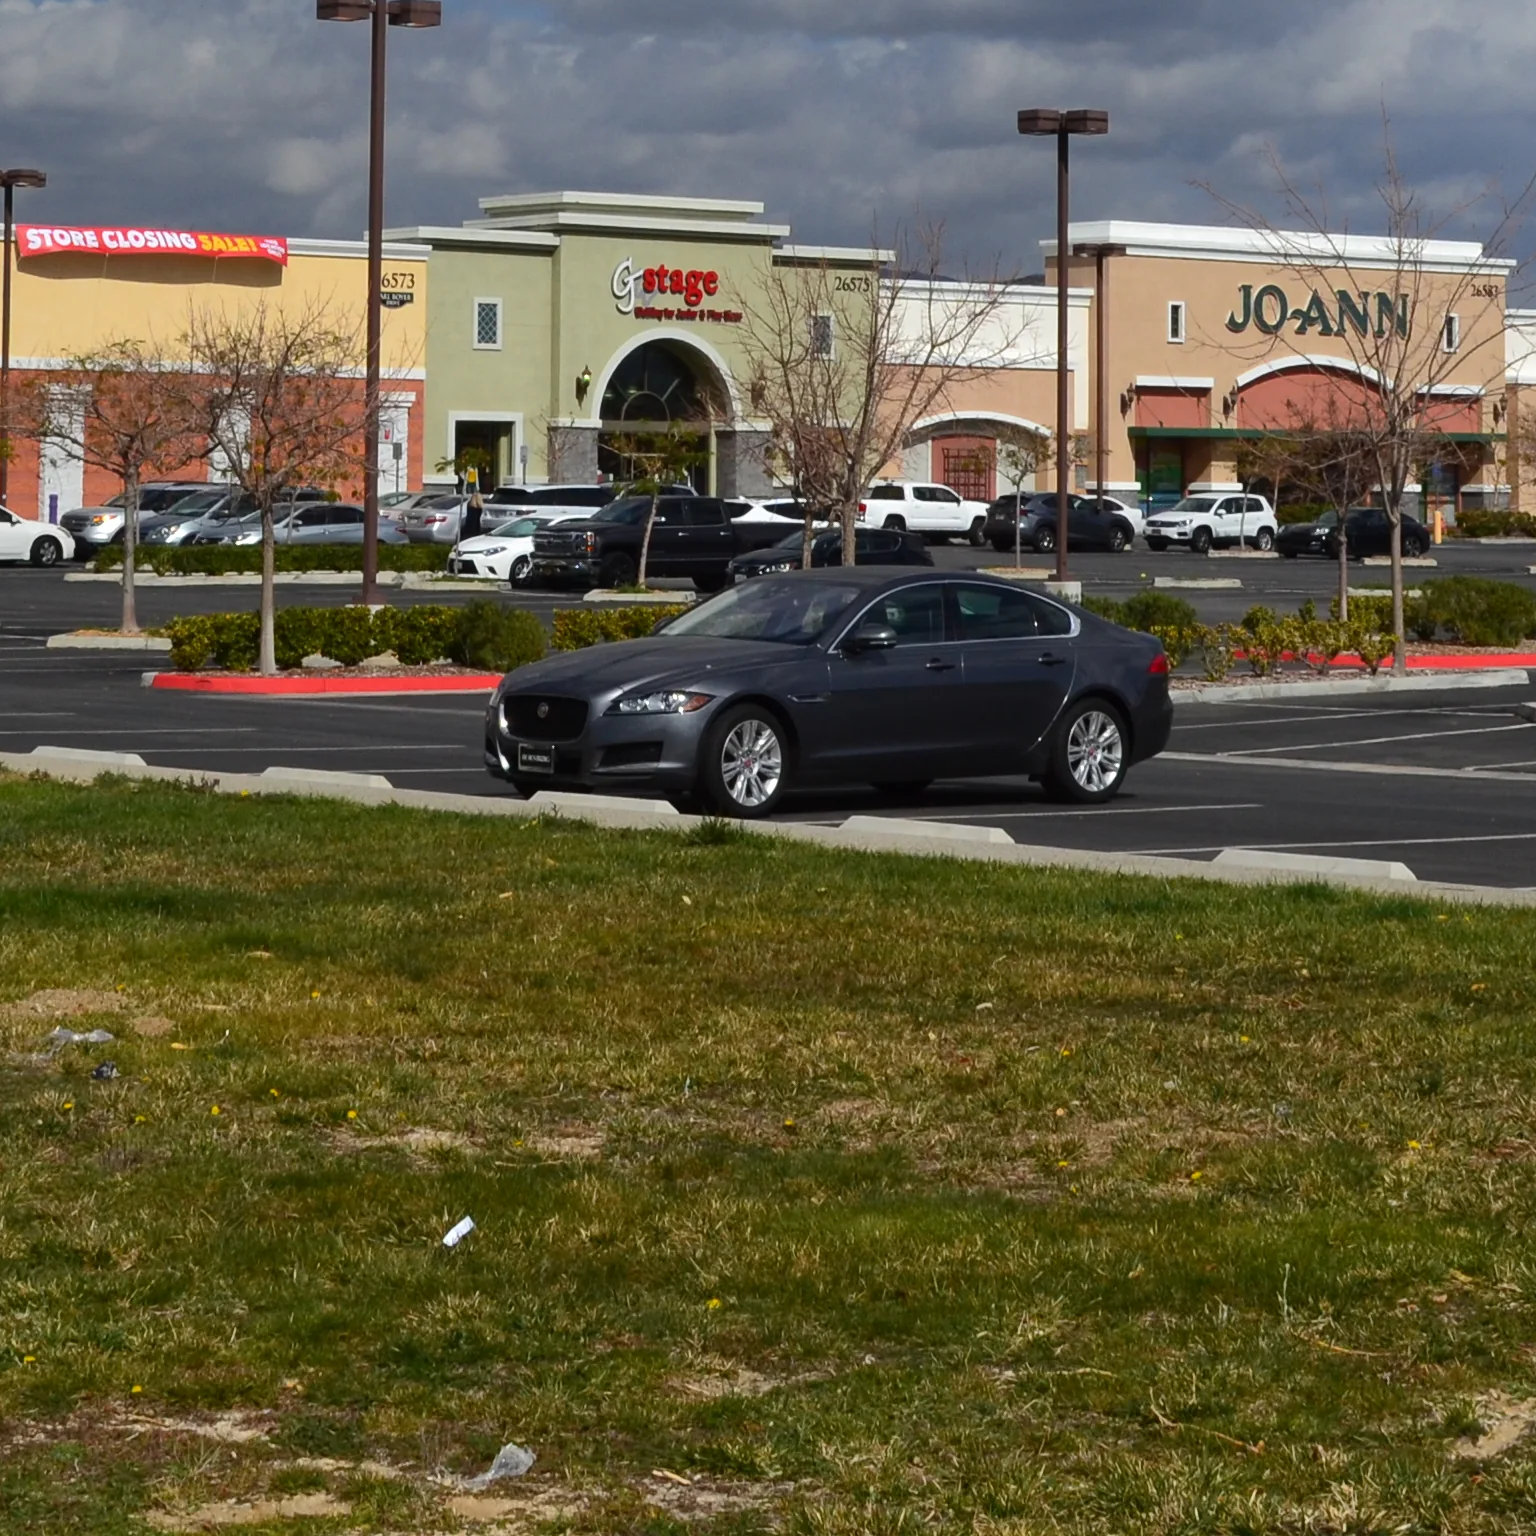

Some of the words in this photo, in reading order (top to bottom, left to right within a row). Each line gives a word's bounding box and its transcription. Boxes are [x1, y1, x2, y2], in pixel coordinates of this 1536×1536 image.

[26, 228, 99, 249] STORE
[102, 230, 197, 250] CLOSING
[198, 234, 257, 252] SALE!
[381, 272, 415, 289] 6573
[835, 276, 870, 292] 26575
